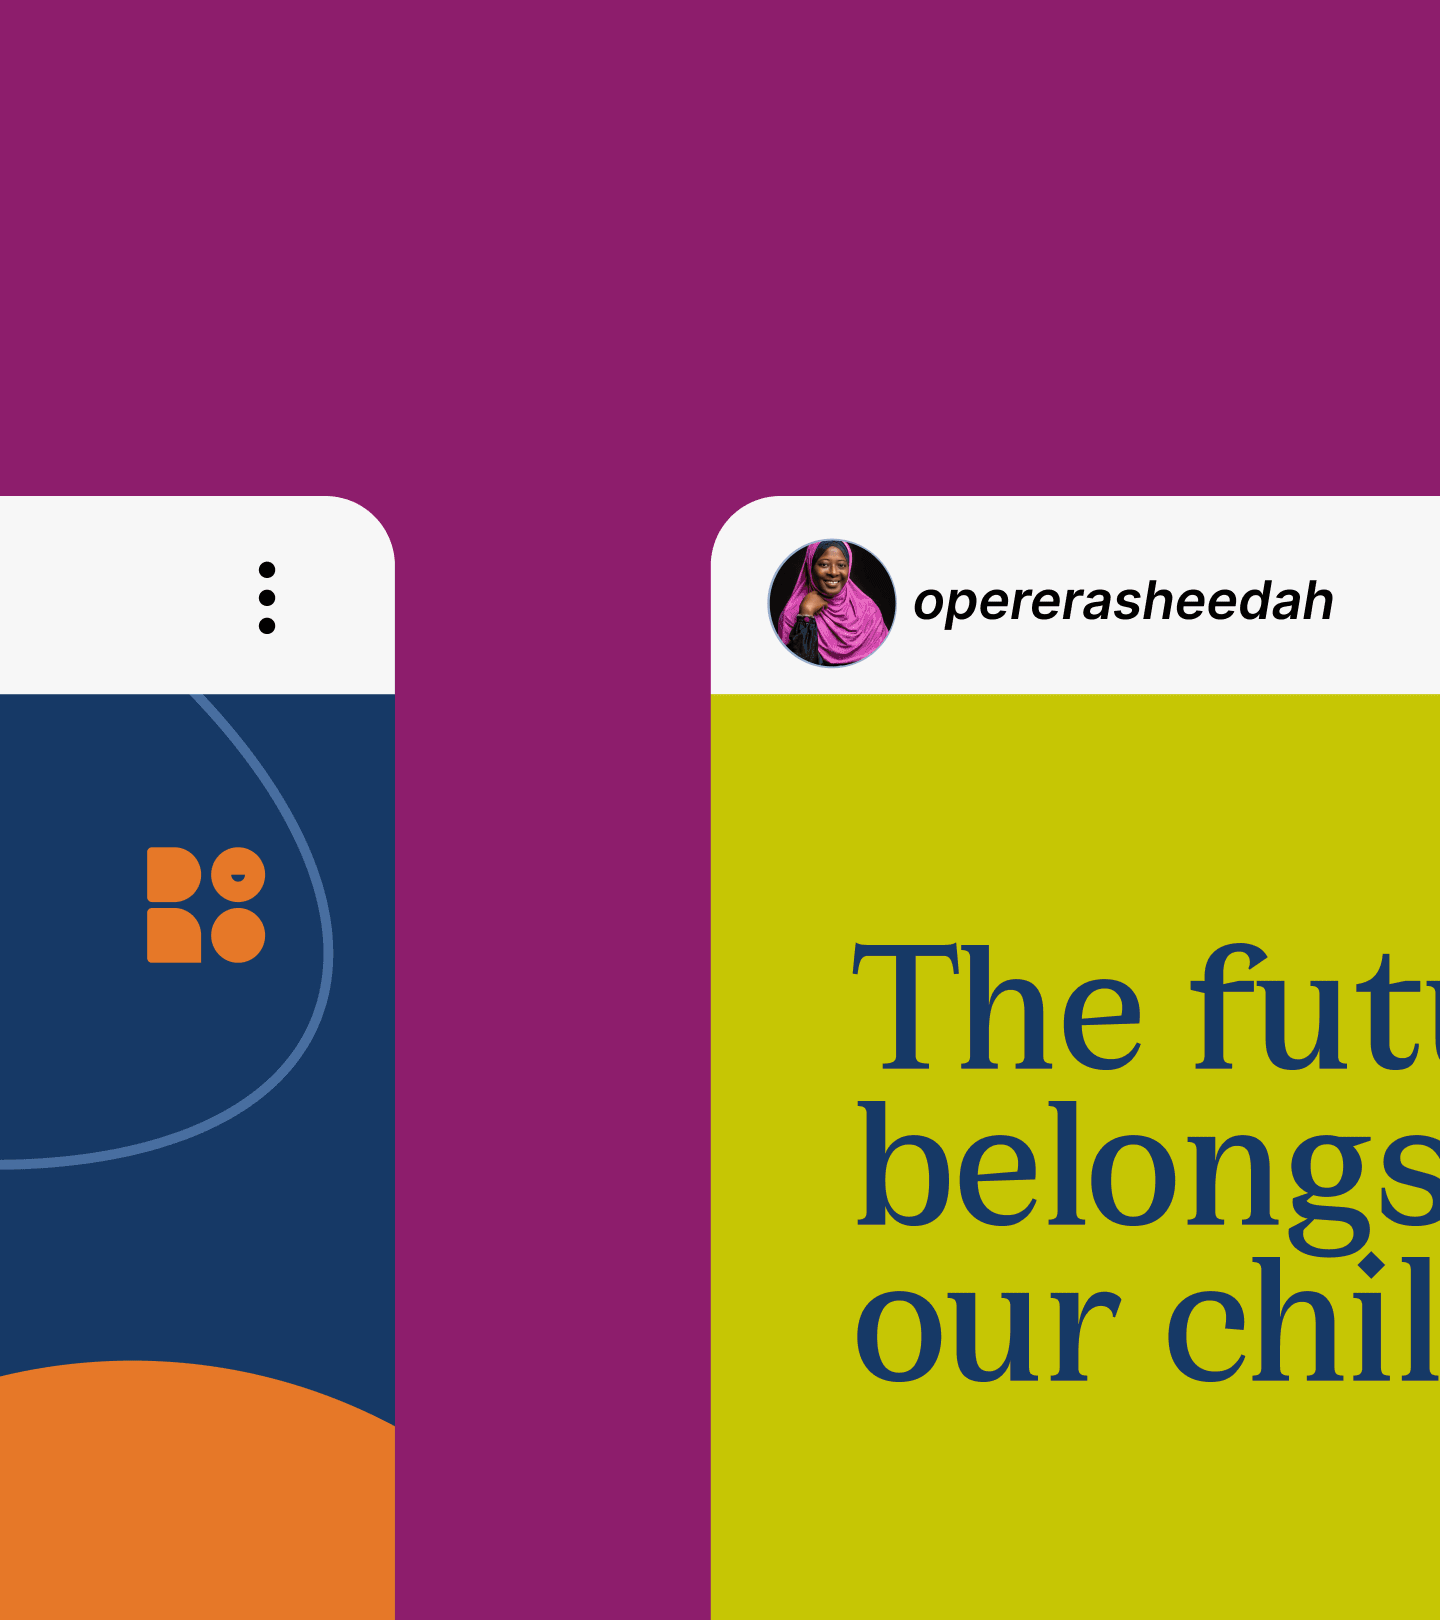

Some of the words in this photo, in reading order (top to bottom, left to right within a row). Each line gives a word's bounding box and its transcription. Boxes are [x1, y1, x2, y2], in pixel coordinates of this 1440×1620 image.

[914, 579, 1333, 631] opererasheedah
[852, 942, 1142, 1071] The
[856, 1290, 1122, 1383] our
